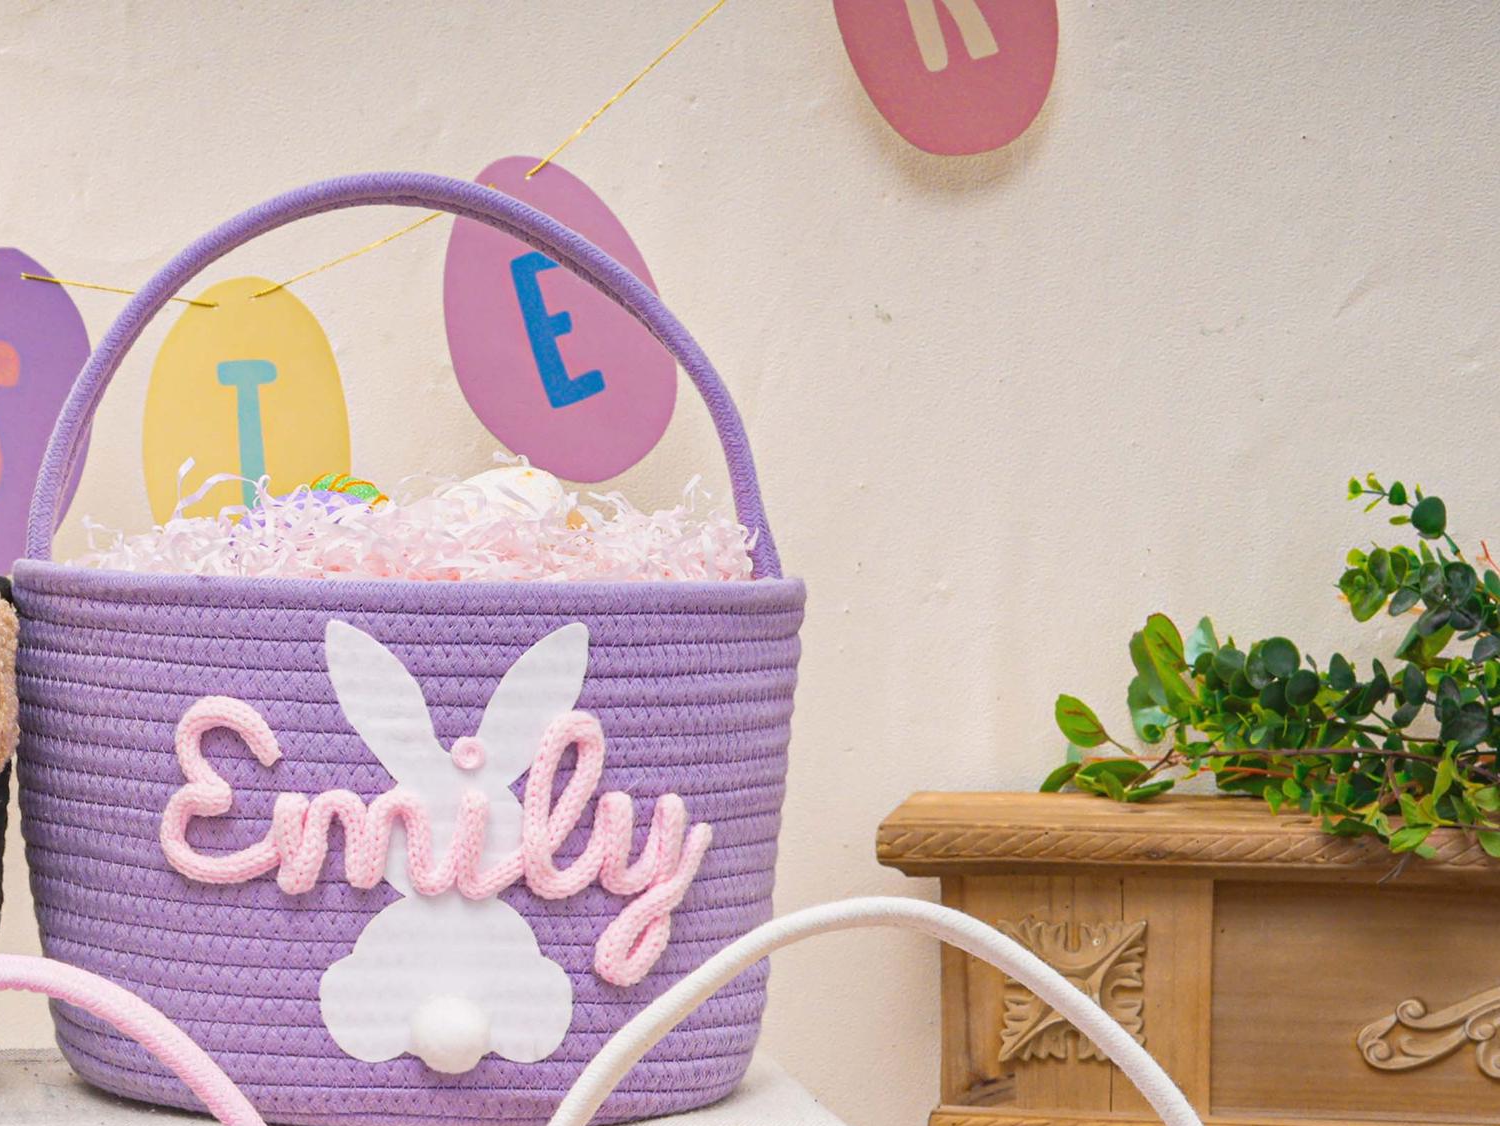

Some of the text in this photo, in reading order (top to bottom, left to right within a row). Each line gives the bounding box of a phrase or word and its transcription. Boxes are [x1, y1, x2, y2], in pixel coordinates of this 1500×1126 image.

[216, 359, 278, 511] T
[509, 250, 607, 409] E
[160, 695, 713, 988] Emily
